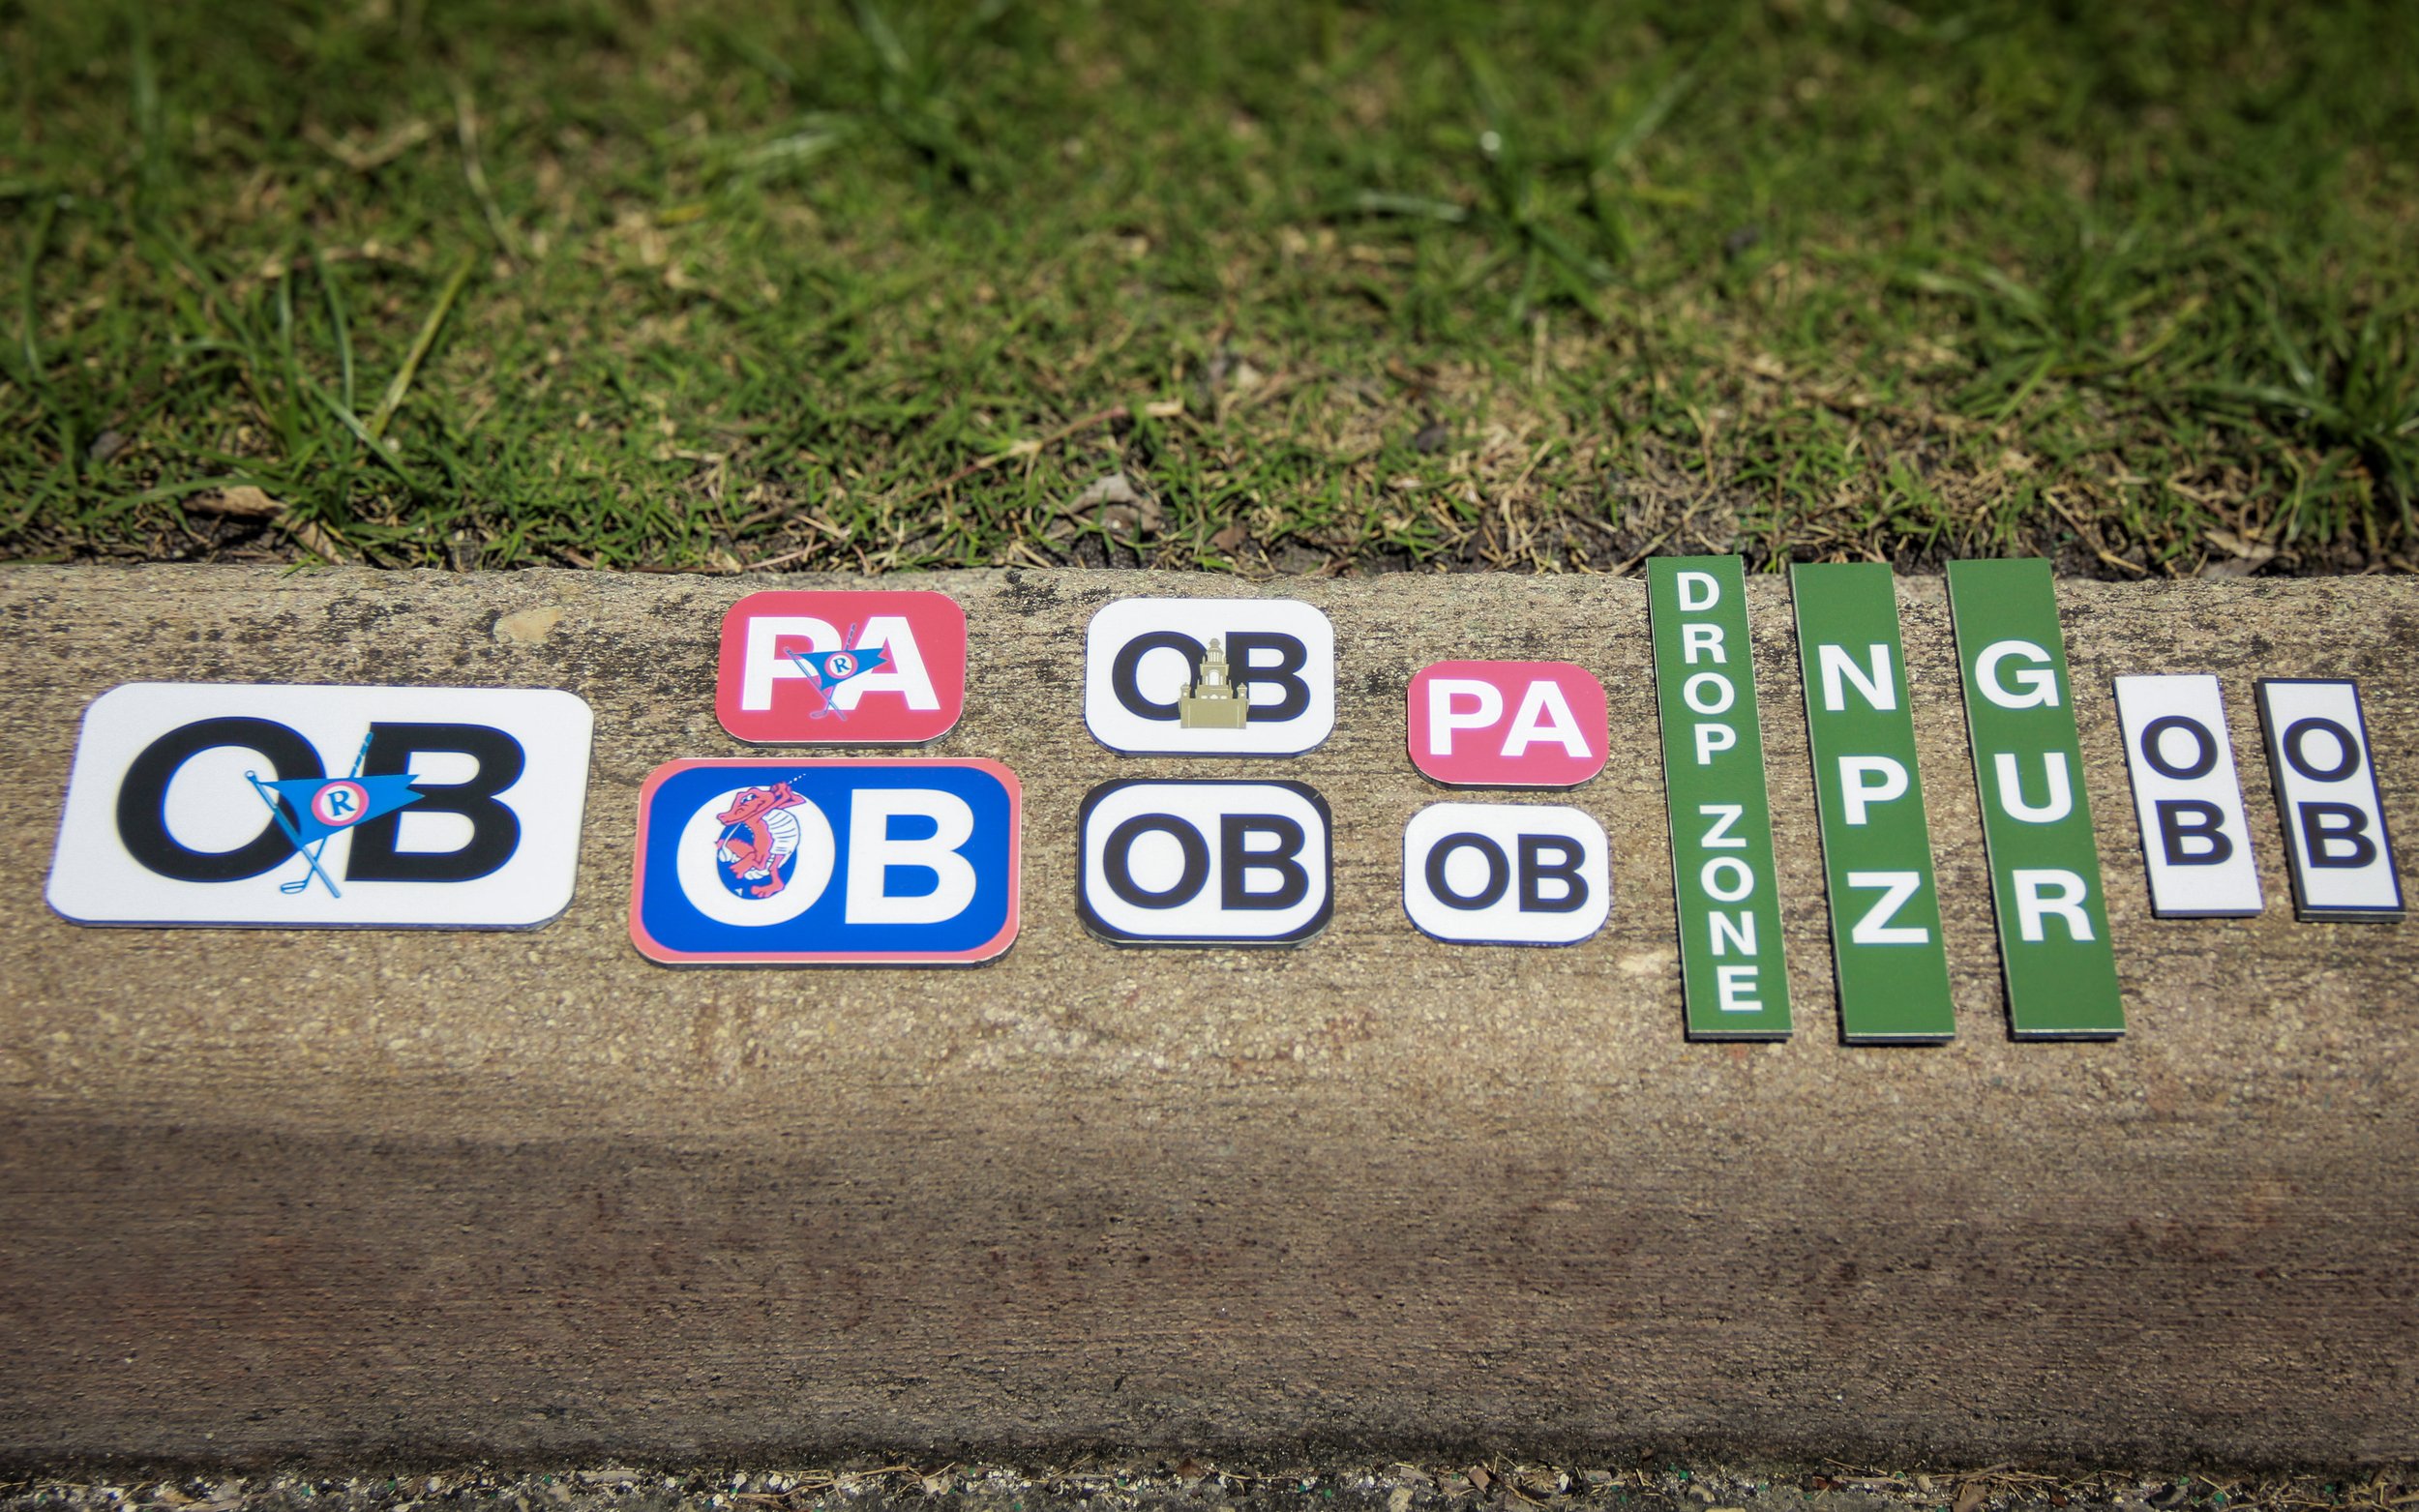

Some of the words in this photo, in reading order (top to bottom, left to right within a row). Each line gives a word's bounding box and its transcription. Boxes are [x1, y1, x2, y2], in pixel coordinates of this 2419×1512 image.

[742, 616, 941, 711] PA
[833, 657, 851, 673] R
[1111, 630, 1311, 722] OB
[1428, 678, 1593, 757] PA
[1677, 572, 1737, 765] DROP
[116, 716, 525, 882] OB
[327, 789, 356, 816] R
[676, 786, 977, 928] OB
[1818, 644, 1929, 944] NPZ
[1975, 639, 2096, 942] GUR
[2140, 715, 2233, 866] OB
[2283, 717, 2377, 869] OB
[1102, 813, 1310, 911] OB
[1424, 832, 1589, 913] OB
[1698, 805, 1763, 1012] ZONE
